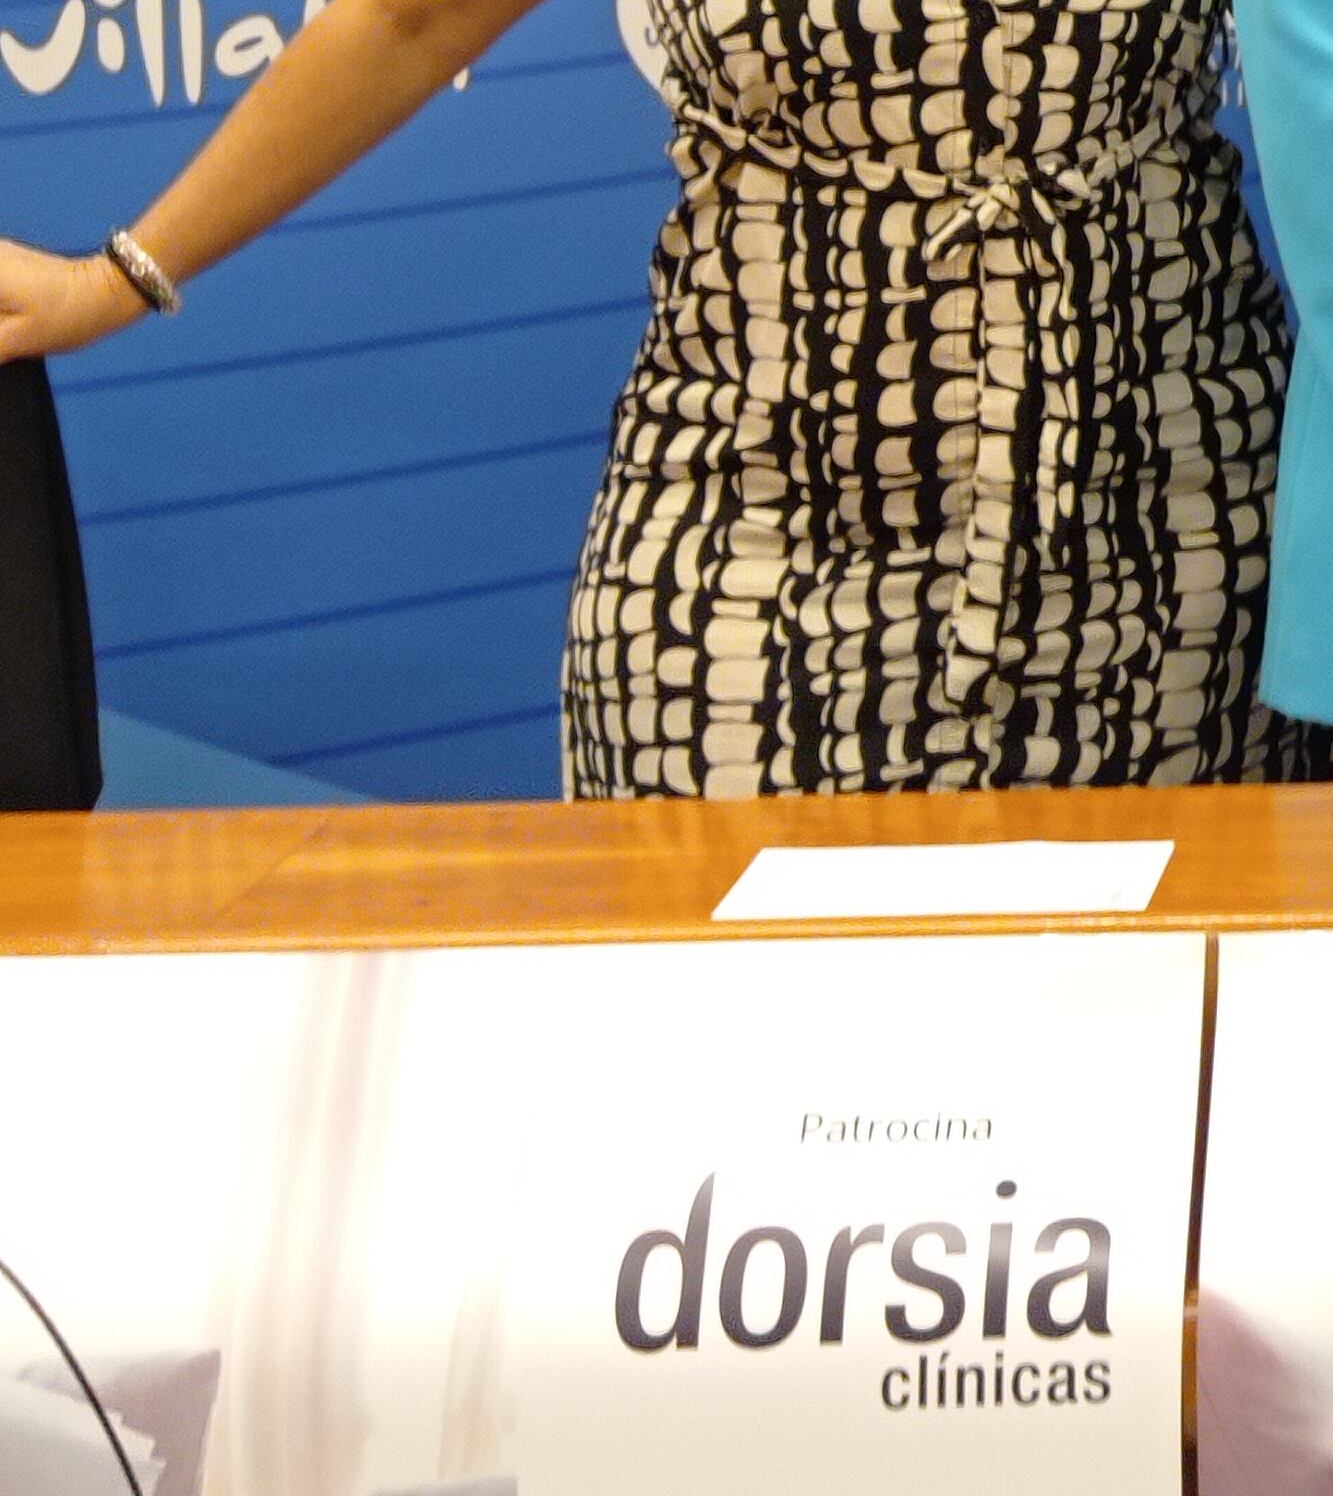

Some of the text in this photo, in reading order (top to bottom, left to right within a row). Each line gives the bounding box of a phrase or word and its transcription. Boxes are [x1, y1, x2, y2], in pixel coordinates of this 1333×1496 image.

[800, 1111, 995, 1145] Patrocina
[614, 1171, 1113, 1354] dorsia
[880, 1351, 1113, 1411] clínicas
